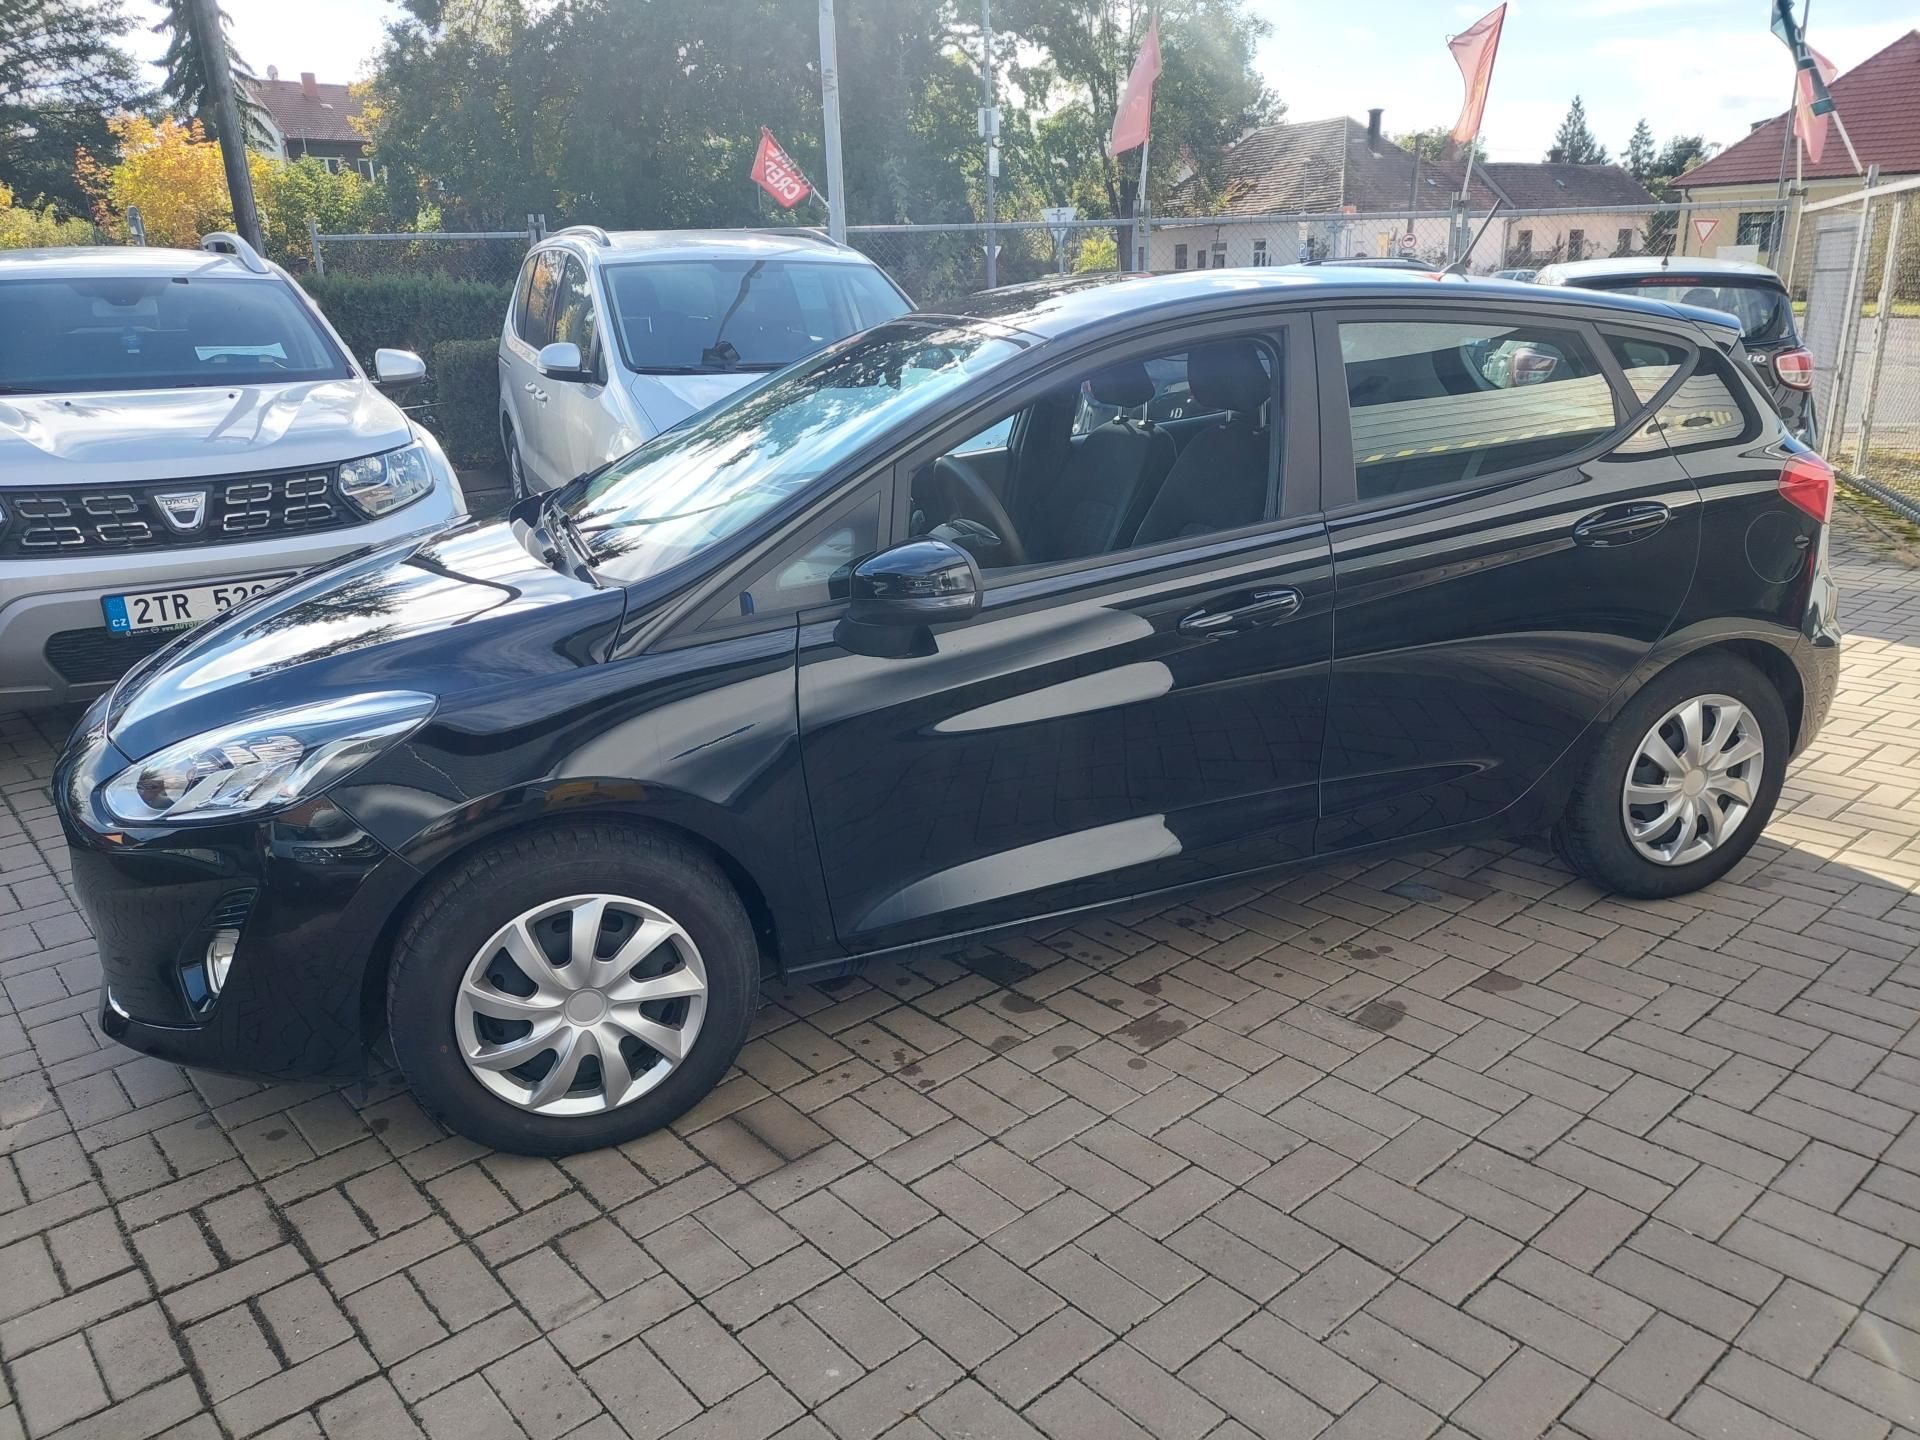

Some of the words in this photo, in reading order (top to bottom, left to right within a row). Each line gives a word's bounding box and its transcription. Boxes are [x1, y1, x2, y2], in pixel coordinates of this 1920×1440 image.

[165, 497, 199, 506] DACIA
[133, 593, 192, 625] 2TR
[112, 617, 128, 628] CZ
